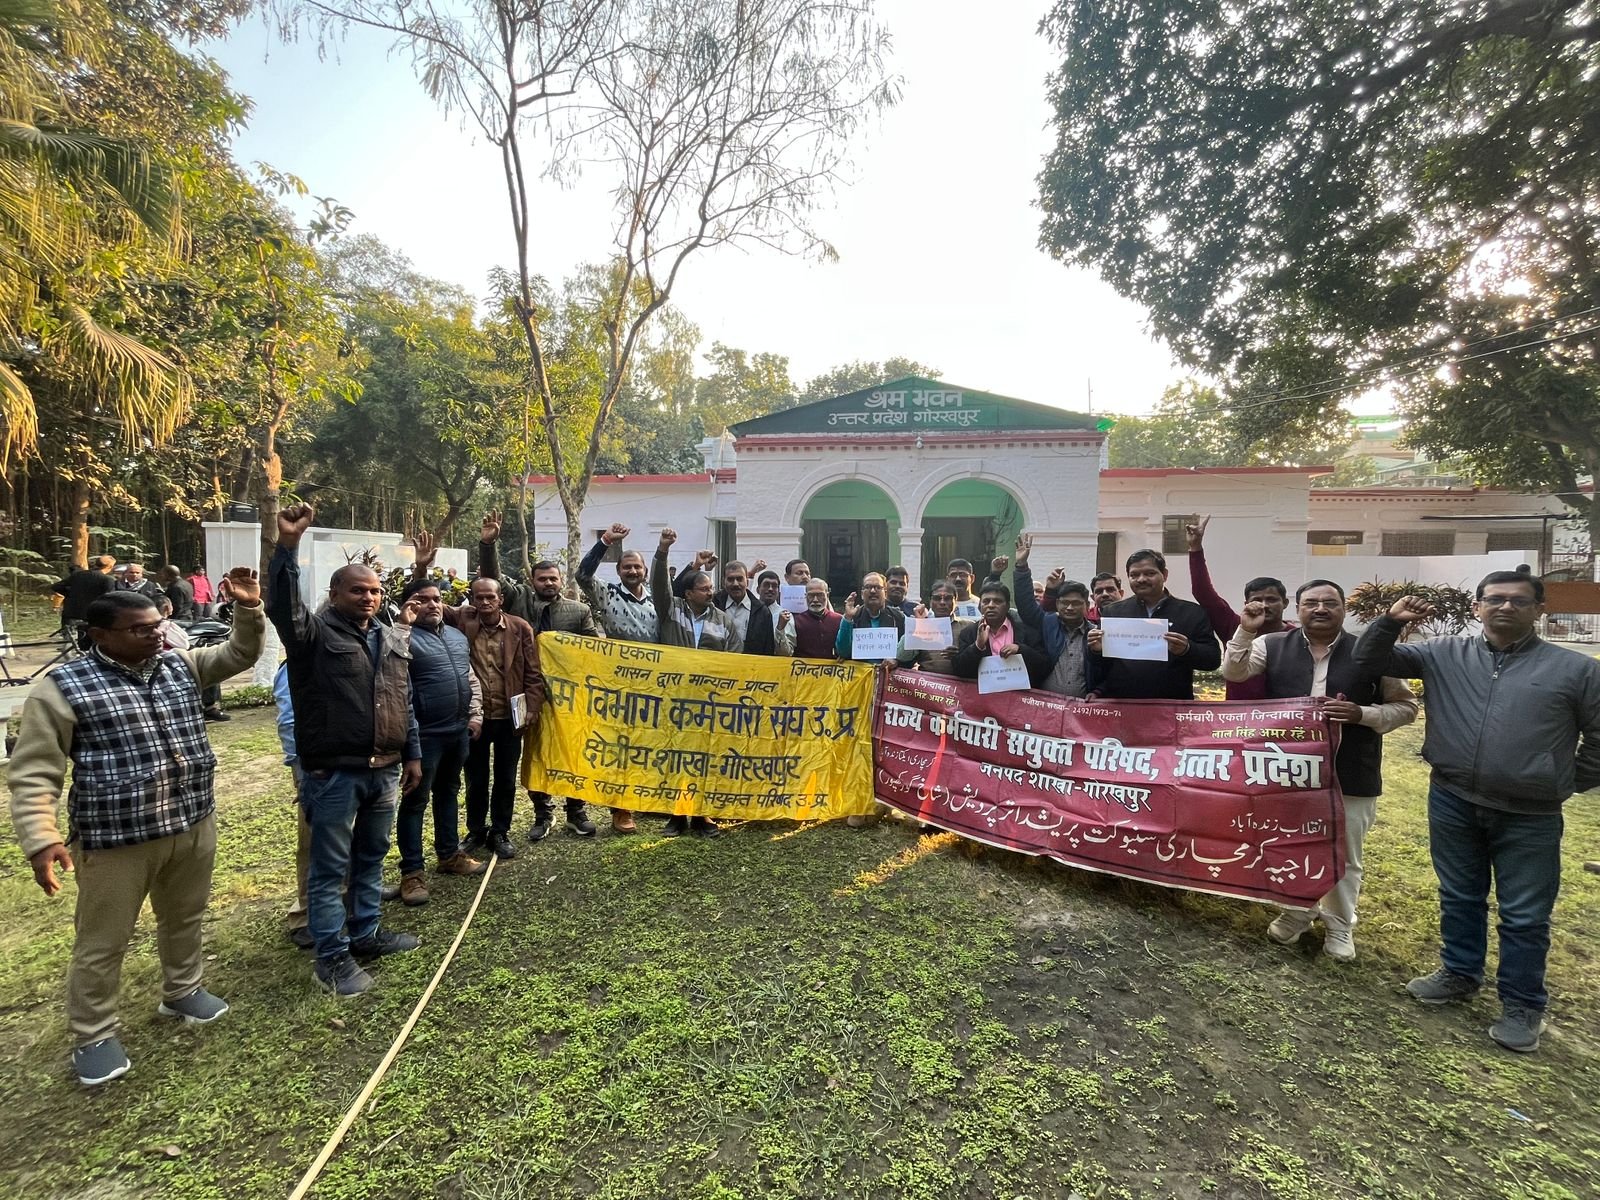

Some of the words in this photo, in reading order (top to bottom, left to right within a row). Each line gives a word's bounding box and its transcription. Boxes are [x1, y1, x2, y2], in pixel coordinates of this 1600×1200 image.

[911, 389, 965, 408] भवन
[872, 409, 908, 425] प्रदेश
[913, 409, 980, 427] गोरखपुर
[855, 631, 874, 641] पुरानी
[618, 643, 664, 663] एकता
[614, 664, 653, 681] शासन
[656, 671, 684, 689] द्वारा
[688, 673, 739, 691] मान्यता
[738, 680, 779, 693] प्राप्त
[584, 675, 663, 731] विभाग
[669, 691, 764, 739] कर्मचारी
[769, 701, 808, 740] संघ
[1175, 710, 1214, 722] कर्मचारी
[1217, 712, 1247, 723] एकता
[884, 702, 925, 731] राज्य
[929, 711, 1002, 750] कर्मचारी
[1006, 724, 1076, 769] संयुक्त
[1083, 737, 1159, 781] परिषद,
[1173, 748, 1234, 781] उत्तर
[1242, 741, 1324, 788] प्रदेश
[1212, 729, 1233, 739] लाल
[1235, 726, 1256, 738] सिंह
[1259, 728, 1288, 740] अमर
[1290, 726, 1306, 742] रहें
[583, 730, 653, 770] क्षेत्रीय
[979, 761, 1026, 786] जनपद
[593, 779, 630, 796] राज्य
[633, 780, 699, 802] कर्मचारी
[703, 788, 753, 809] संयुक्त
[757, 787, 794, 808] परिषद
